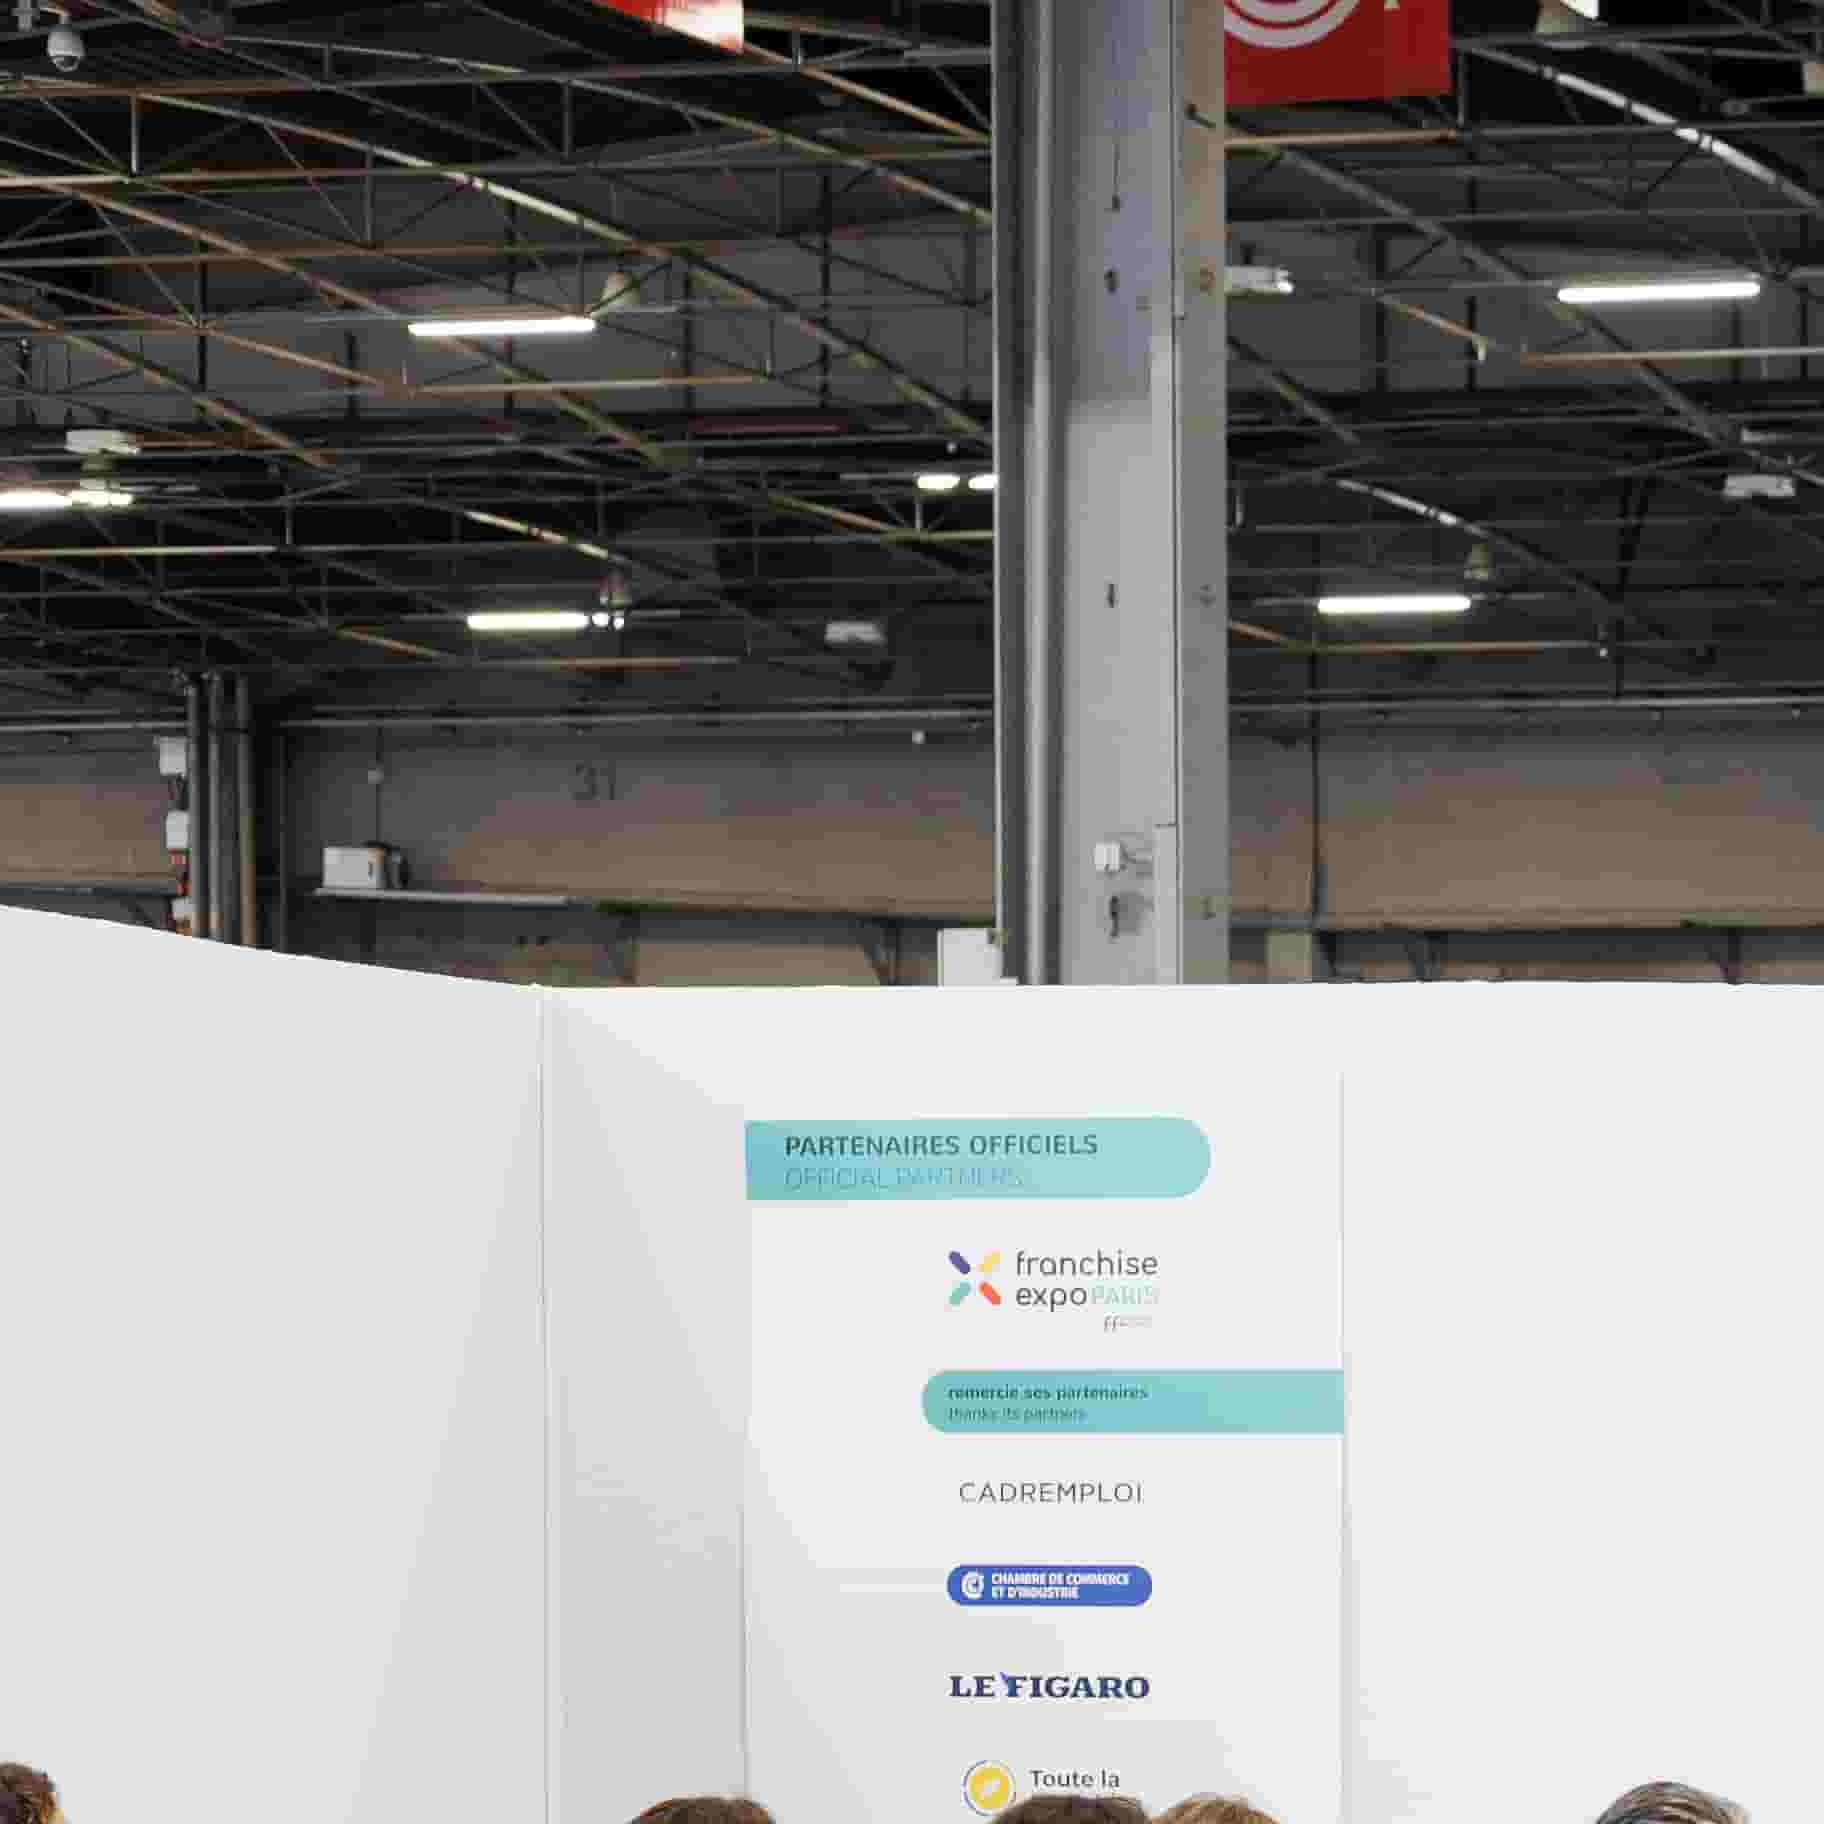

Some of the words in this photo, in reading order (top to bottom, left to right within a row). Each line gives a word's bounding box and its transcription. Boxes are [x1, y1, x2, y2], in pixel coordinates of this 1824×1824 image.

[784, 1135, 960, 1156] PARTENAIRES
[969, 1134, 1098, 1155] OFFICIELS
[1016, 1248, 1158, 1277] franchise
[1015, 1286, 1088, 1313] expo
[1056, 1384, 1149, 1401] partenaires
[959, 1482, 1145, 1505] CADREMPLOI
[992, 1572, 1046, 1585] CHAMBRE
[1067, 1572, 1129, 1585] COMMERCE
[949, 1675, 996, 1698] LE
[1003, 1675, 1150, 1699] FIGARO
[1029, 1769, 1094, 1788] Toute
[1101, 1768, 1120, 1788] la
